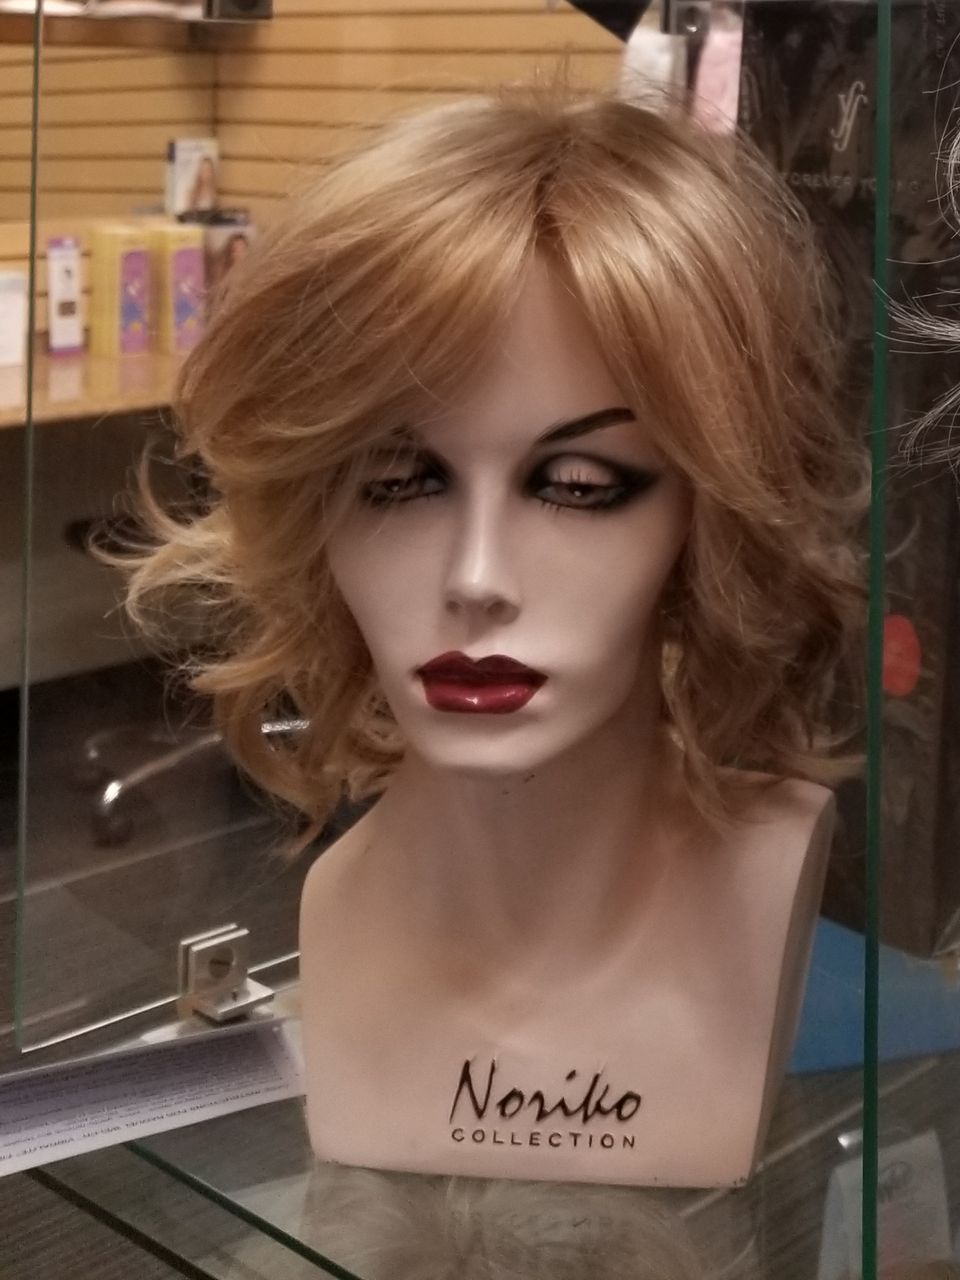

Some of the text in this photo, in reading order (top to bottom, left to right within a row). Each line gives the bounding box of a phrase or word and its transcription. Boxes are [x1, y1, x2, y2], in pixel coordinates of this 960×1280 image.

[860, 177, 921, 194] YONG
[449, 1058, 642, 1125] Noriko
[451, 1127, 636, 1149] COLLECTION
